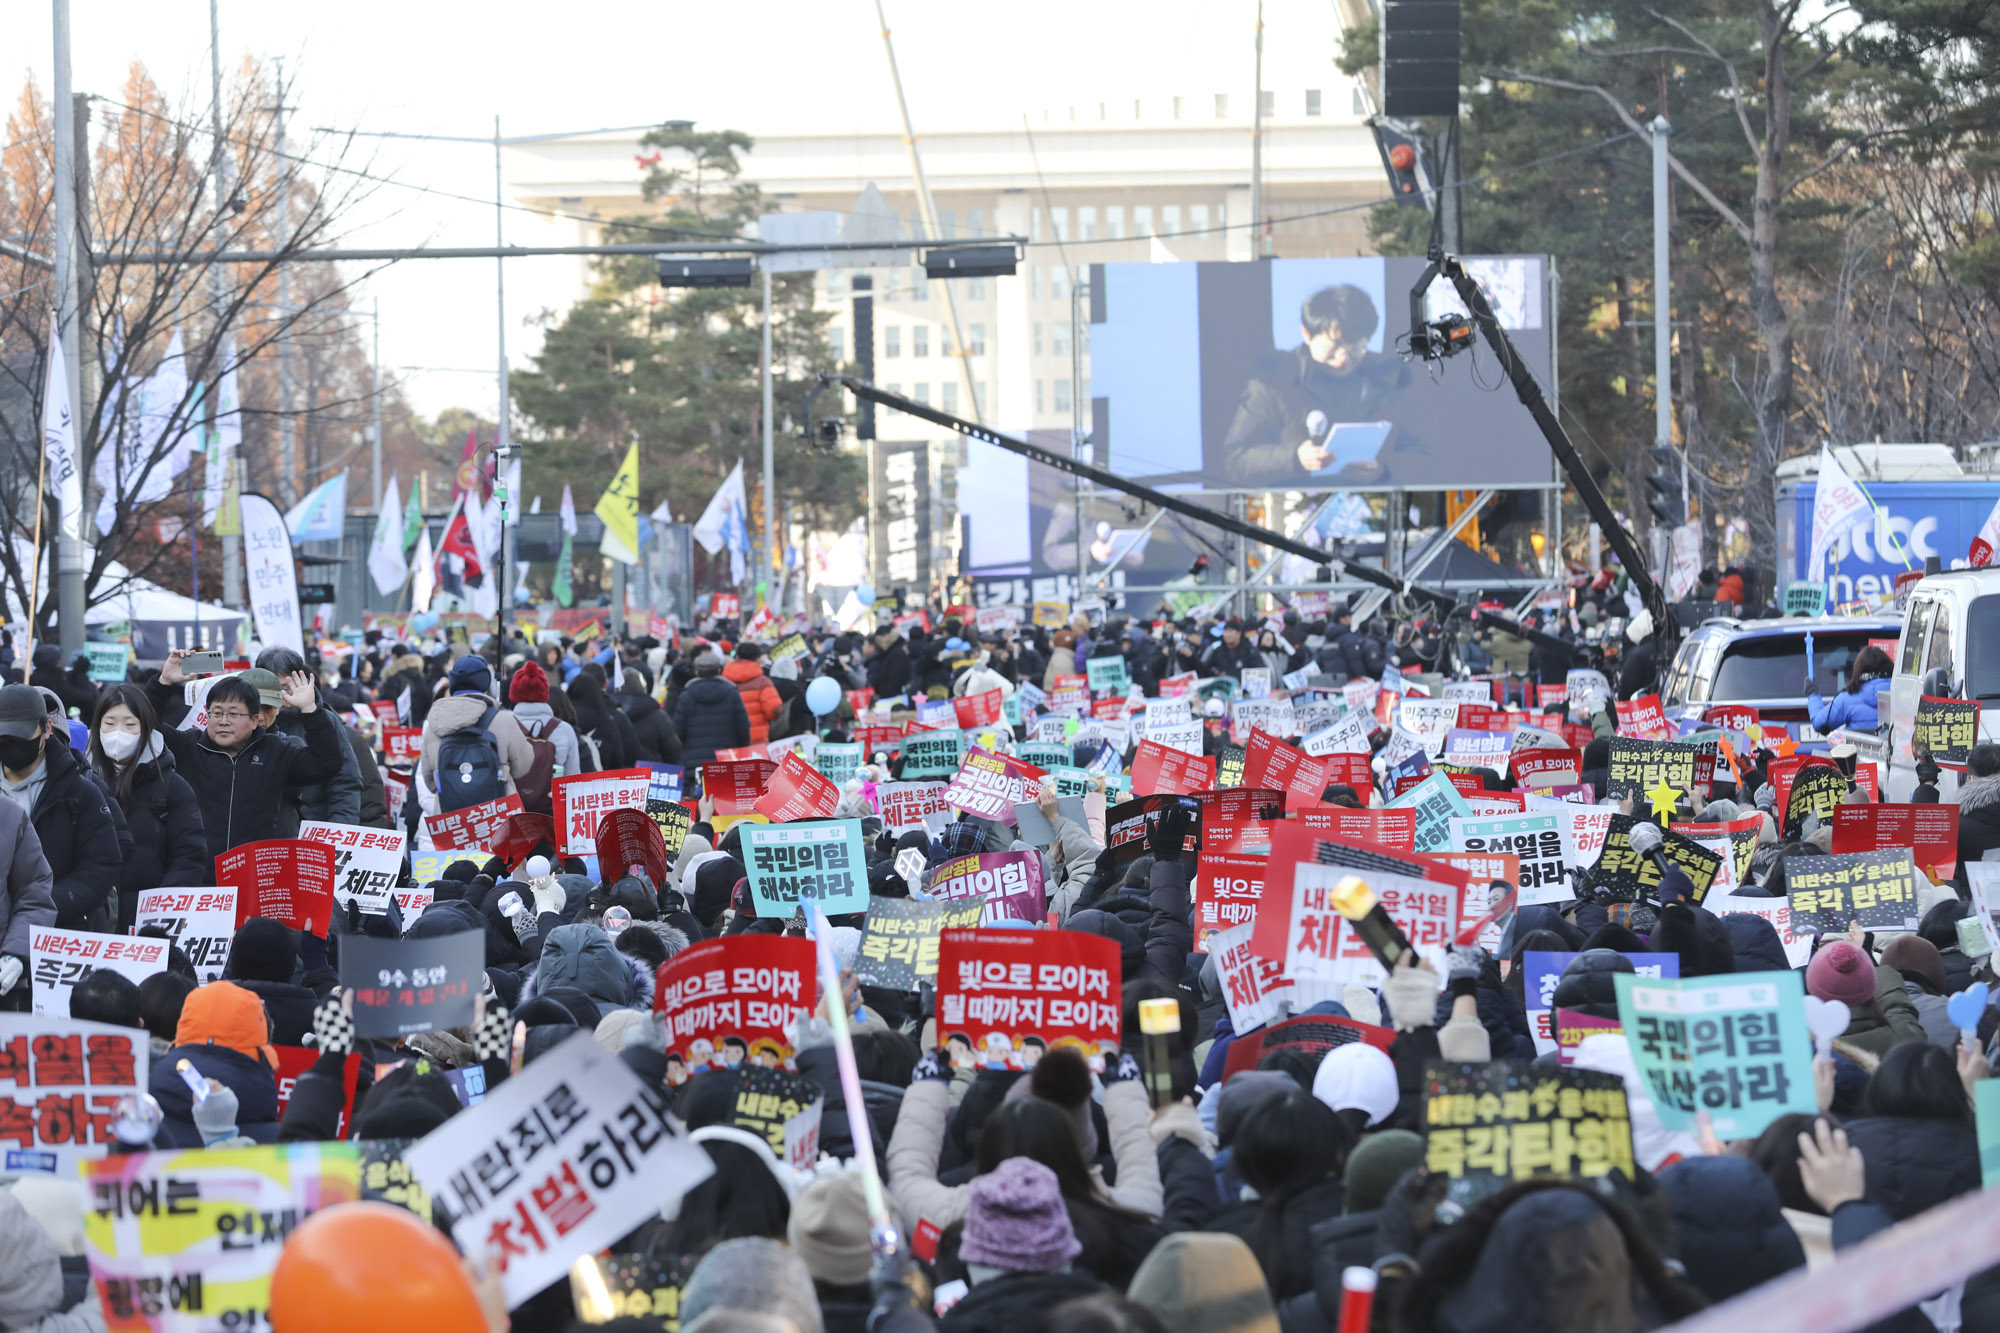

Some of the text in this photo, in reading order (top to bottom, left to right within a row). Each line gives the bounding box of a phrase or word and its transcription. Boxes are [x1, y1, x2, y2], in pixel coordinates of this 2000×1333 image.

[907, 741, 957, 755] 국민의힘
[1612, 751, 1694, 763] 내란수괴 윤석열
[966, 753, 1007, 774] 내란공범
[882, 789, 914, 805] 내란범
[958, 765, 1024, 802] 국민의힘
[572, 790, 614, 811] 내란범
[429, 800, 507, 835] 내란 수괴에
[360, 833, 402, 852] 윤석열
[754, 842, 850, 873] 국민의힘
[338, 868, 397, 897] 체포!
[758, 872, 855, 902] 해산하라
[931, 855, 981, 889] 내란공범
[1791, 860, 1911, 889] 내란수괴 윤석열
[140, 893, 235, 914] 내란수괴 윤석열
[1793, 878, 1914, 913] 즉각 탄핵!
[868, 916, 932, 934] 내란수괴
[33, 933, 164, 963] 내란수괴 윤석열
[665, 967, 802, 1012] 빛으로 모이자
[958, 960, 1110, 998] 빛으로 모이자
[1047, 1001, 1120, 1034] 모이자
[1637, 1012, 1782, 1061] 국민의힘
[434, 1083, 590, 1218] 내란죄로
[485, 1091, 679, 1274] 처벌하라
